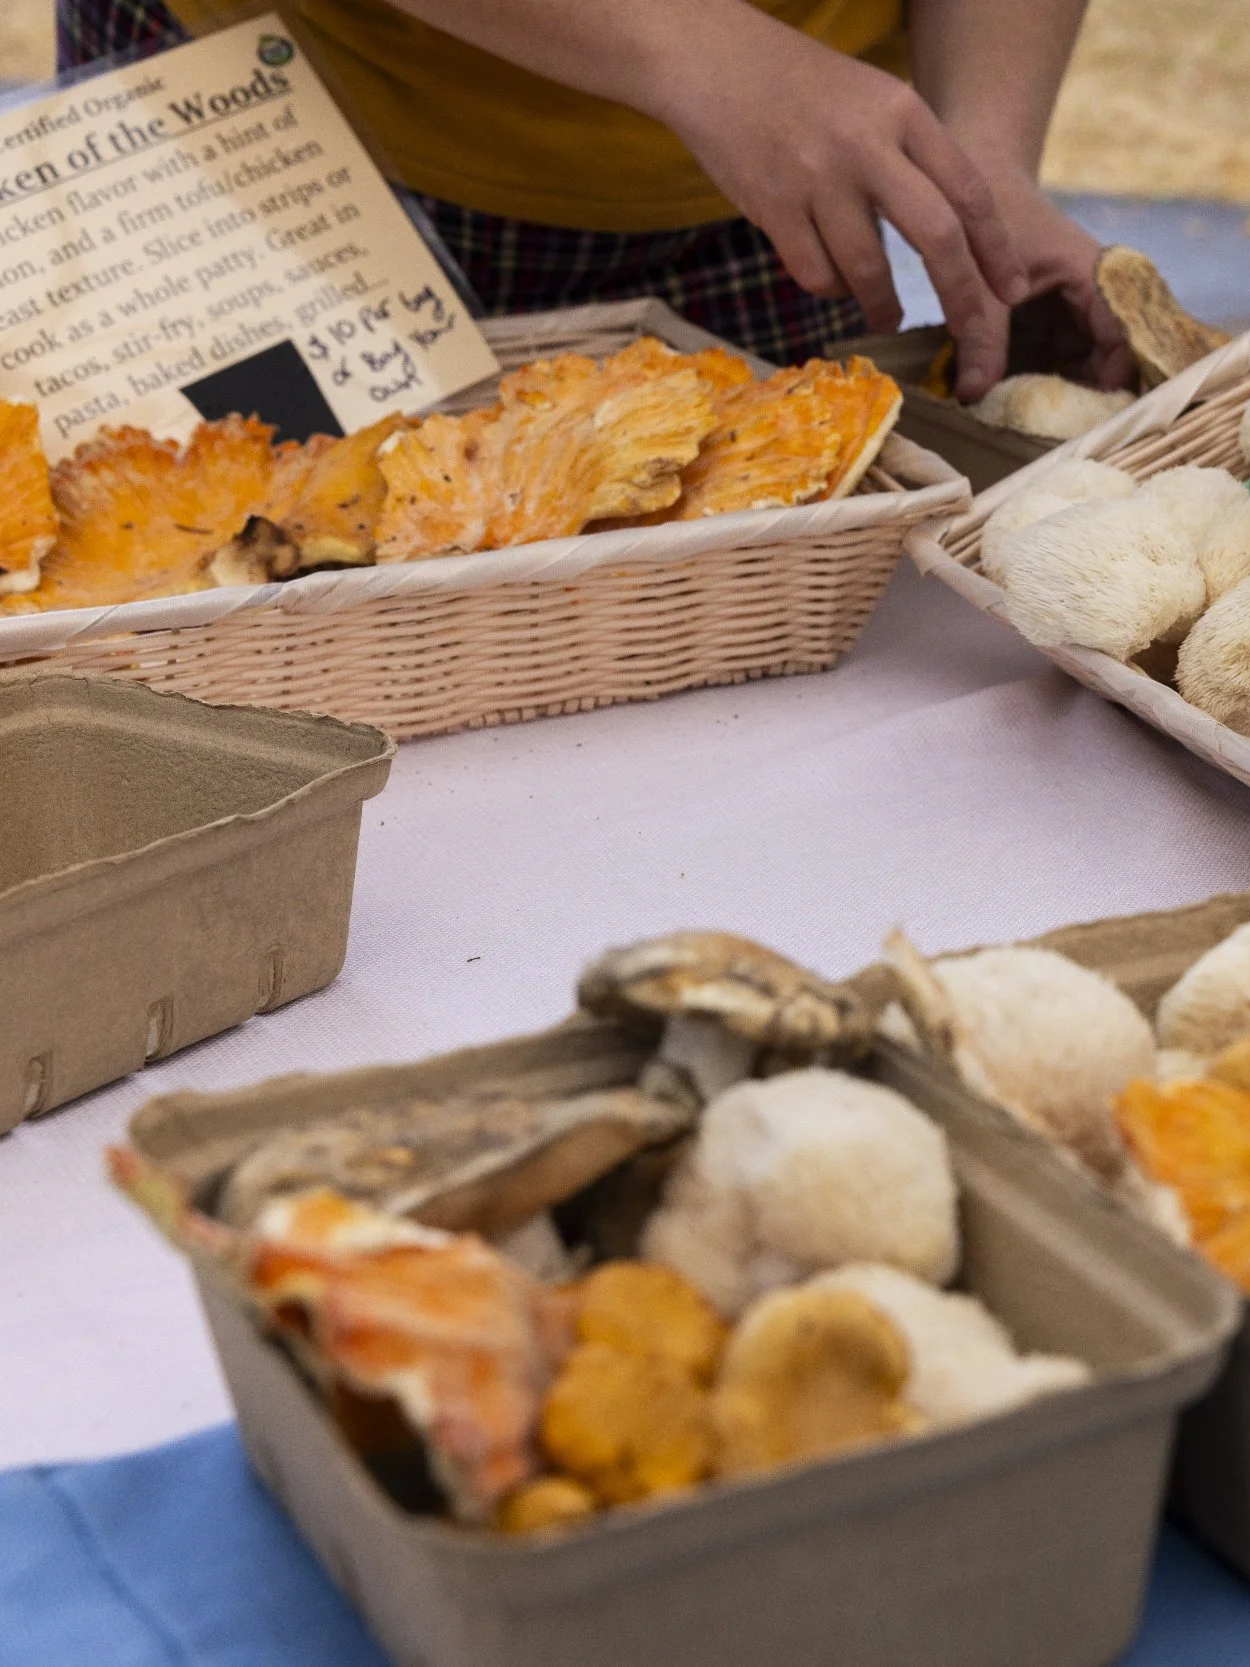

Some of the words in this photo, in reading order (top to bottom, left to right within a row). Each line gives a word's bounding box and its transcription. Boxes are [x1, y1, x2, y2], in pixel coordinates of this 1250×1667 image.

[0, 104, 82, 155] ertified
[83, 75, 165, 118] Organic
[66, 174, 138, 217] flavor
[142, 148, 199, 184] with
[202, 142, 218, 162] a
[214, 121, 270, 153] hint
[271, 104, 299, 133] of
[67, 132, 103, 172] of
[107, 119, 166, 156] the
[167, 67, 291, 126] Woods
[45, 258, 144, 307] texture.
[141, 226, 202, 266] Slice
[206, 203, 257, 240] into
[258, 179, 325, 217] strips
[325, 165, 352, 189] or
[49, 226, 97, 267] and
[101, 226, 117, 244] a
[117, 202, 174, 237] firm
[174, 139, 325, 213] tofu/chicken
[1, 327, 65, 372] cook
[67, 317, 96, 344] as
[98, 309, 116, 328] a
[115, 272, 192, 318] whole
[195, 247, 266, 292] patty.
[264, 213, 331, 252] Great
[333, 201, 361, 226] in
[34, 354, 111, 399] tacos,
[112, 312, 207, 366] stir-fry,
[206, 278, 286, 323] soups,
[284, 240, 368, 284] sauces,
[54, 391, 131, 440] pasta,
[126, 342, 207, 398] baked
[208, 314, 294, 362] dishes,
[331, 354, 354, 388] or
